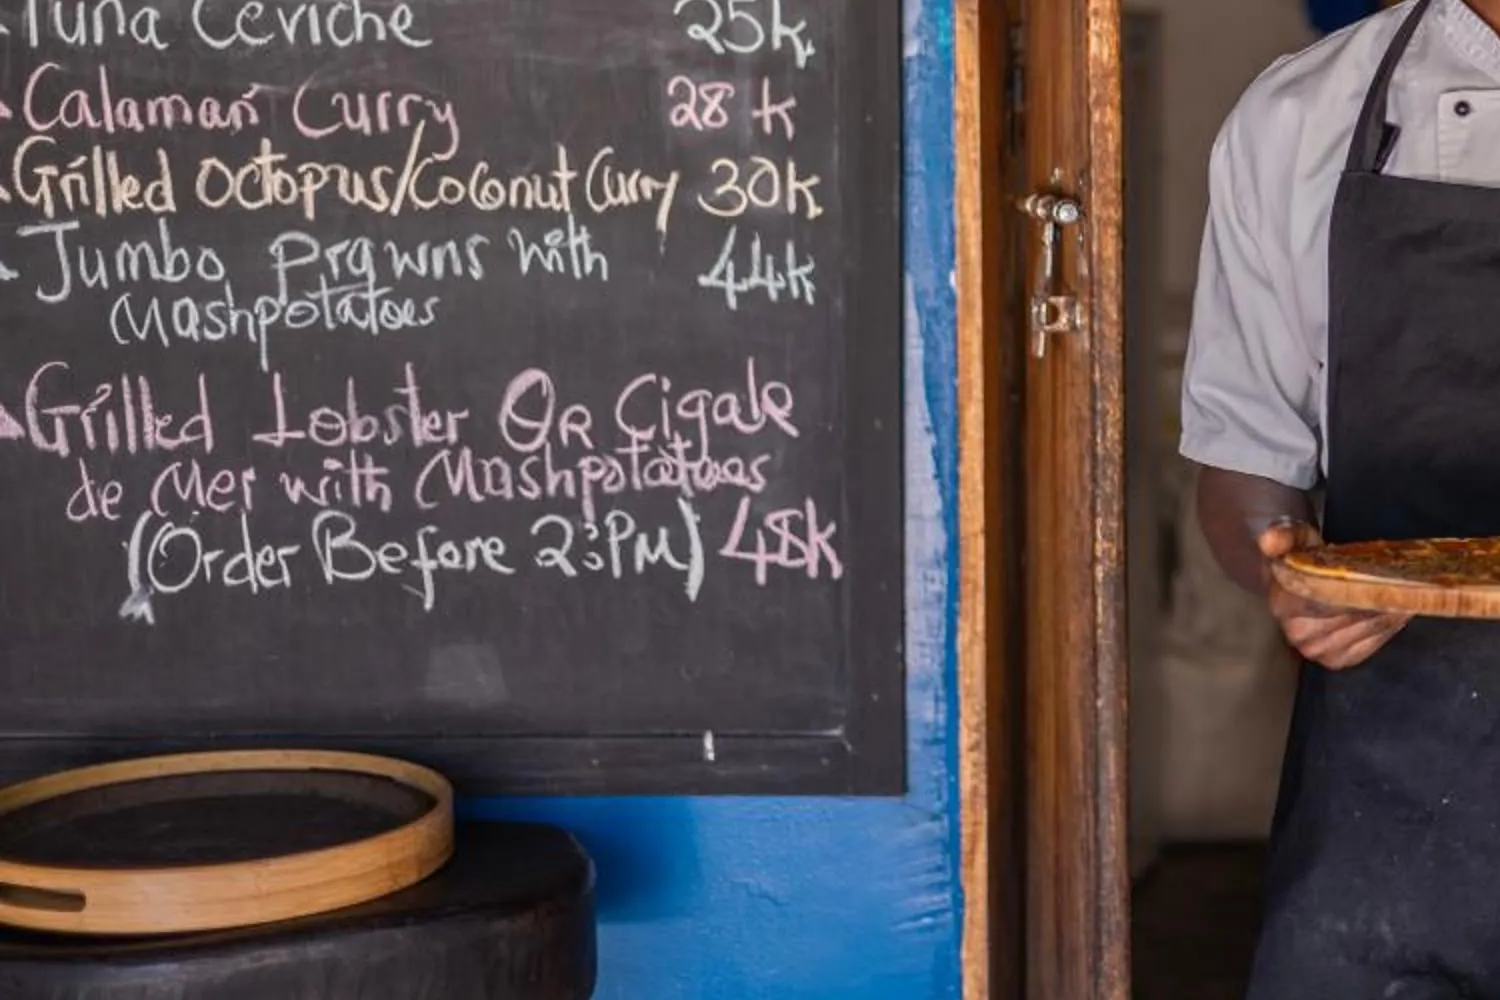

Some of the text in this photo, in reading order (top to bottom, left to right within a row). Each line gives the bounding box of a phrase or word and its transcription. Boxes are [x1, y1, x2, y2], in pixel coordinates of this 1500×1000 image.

[293, 75, 459, 160] Curry
[13, 135, 176, 218] Grilled
[17, 218, 225, 302] Jumbo
[268, 226, 490, 305] Prawns
[506, 213, 608, 281] with
[25, 361, 213, 457] Grilled
[253, 362, 469, 446] Lobster
[66, 458, 123, 522] de
[151, 459, 256, 517] Mer
[280, 449, 391, 513] with
[312, 510, 516, 611] Before
